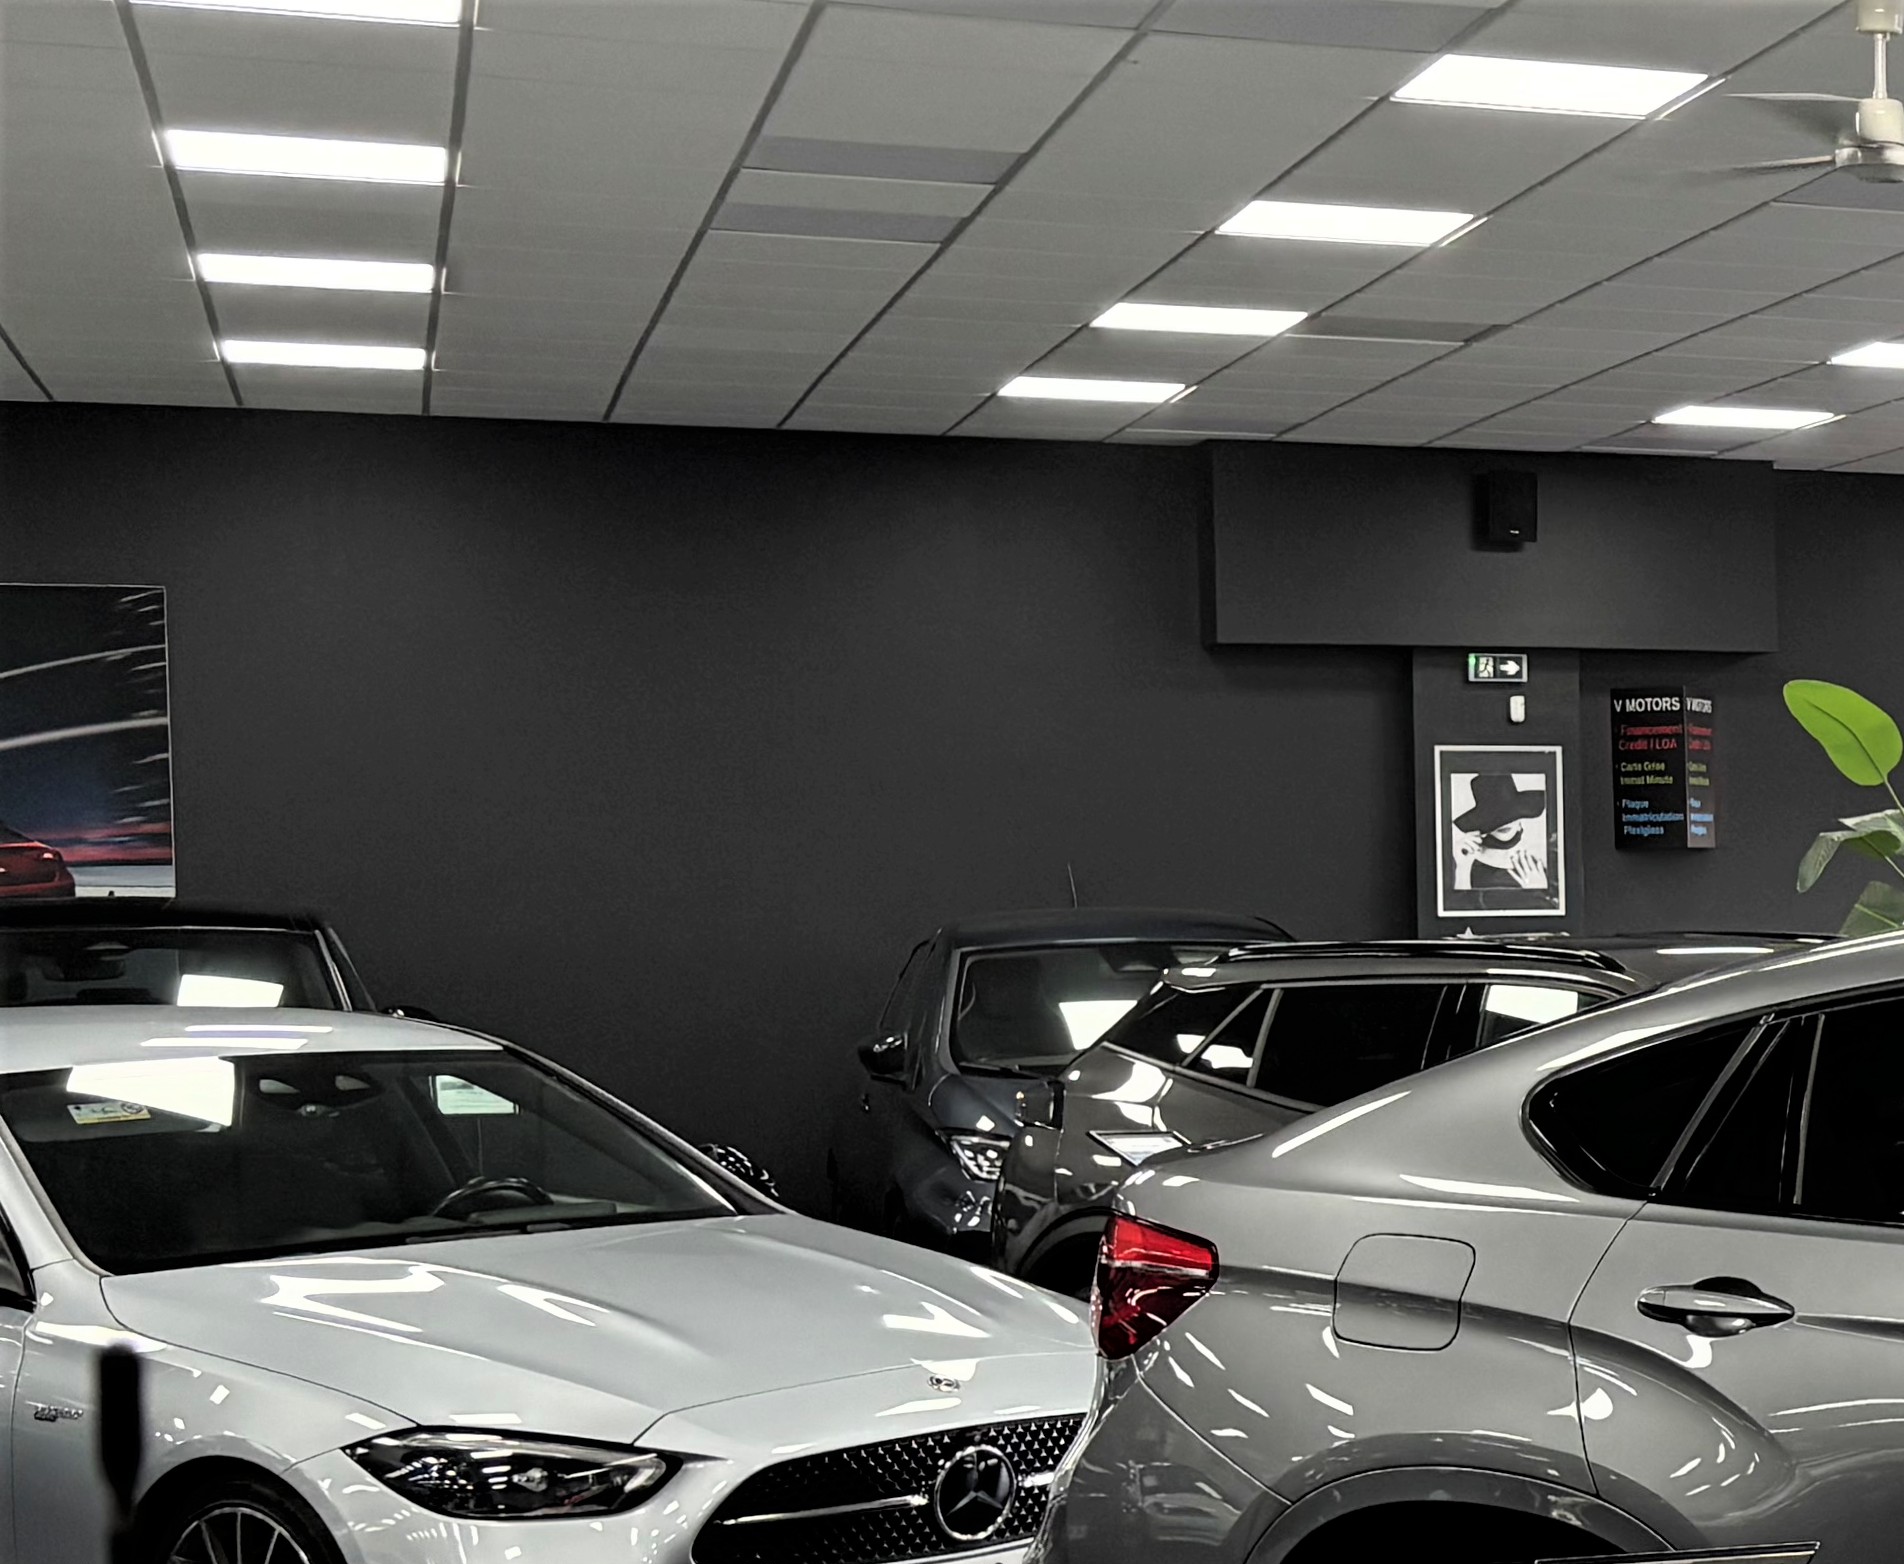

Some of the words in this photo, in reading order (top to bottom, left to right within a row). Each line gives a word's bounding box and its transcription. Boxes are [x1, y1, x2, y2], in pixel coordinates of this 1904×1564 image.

[1613, 699, 1622, 713] V
[1626, 697, 1681, 712] MOTORS
[1655, 737, 1678, 750] LOA
